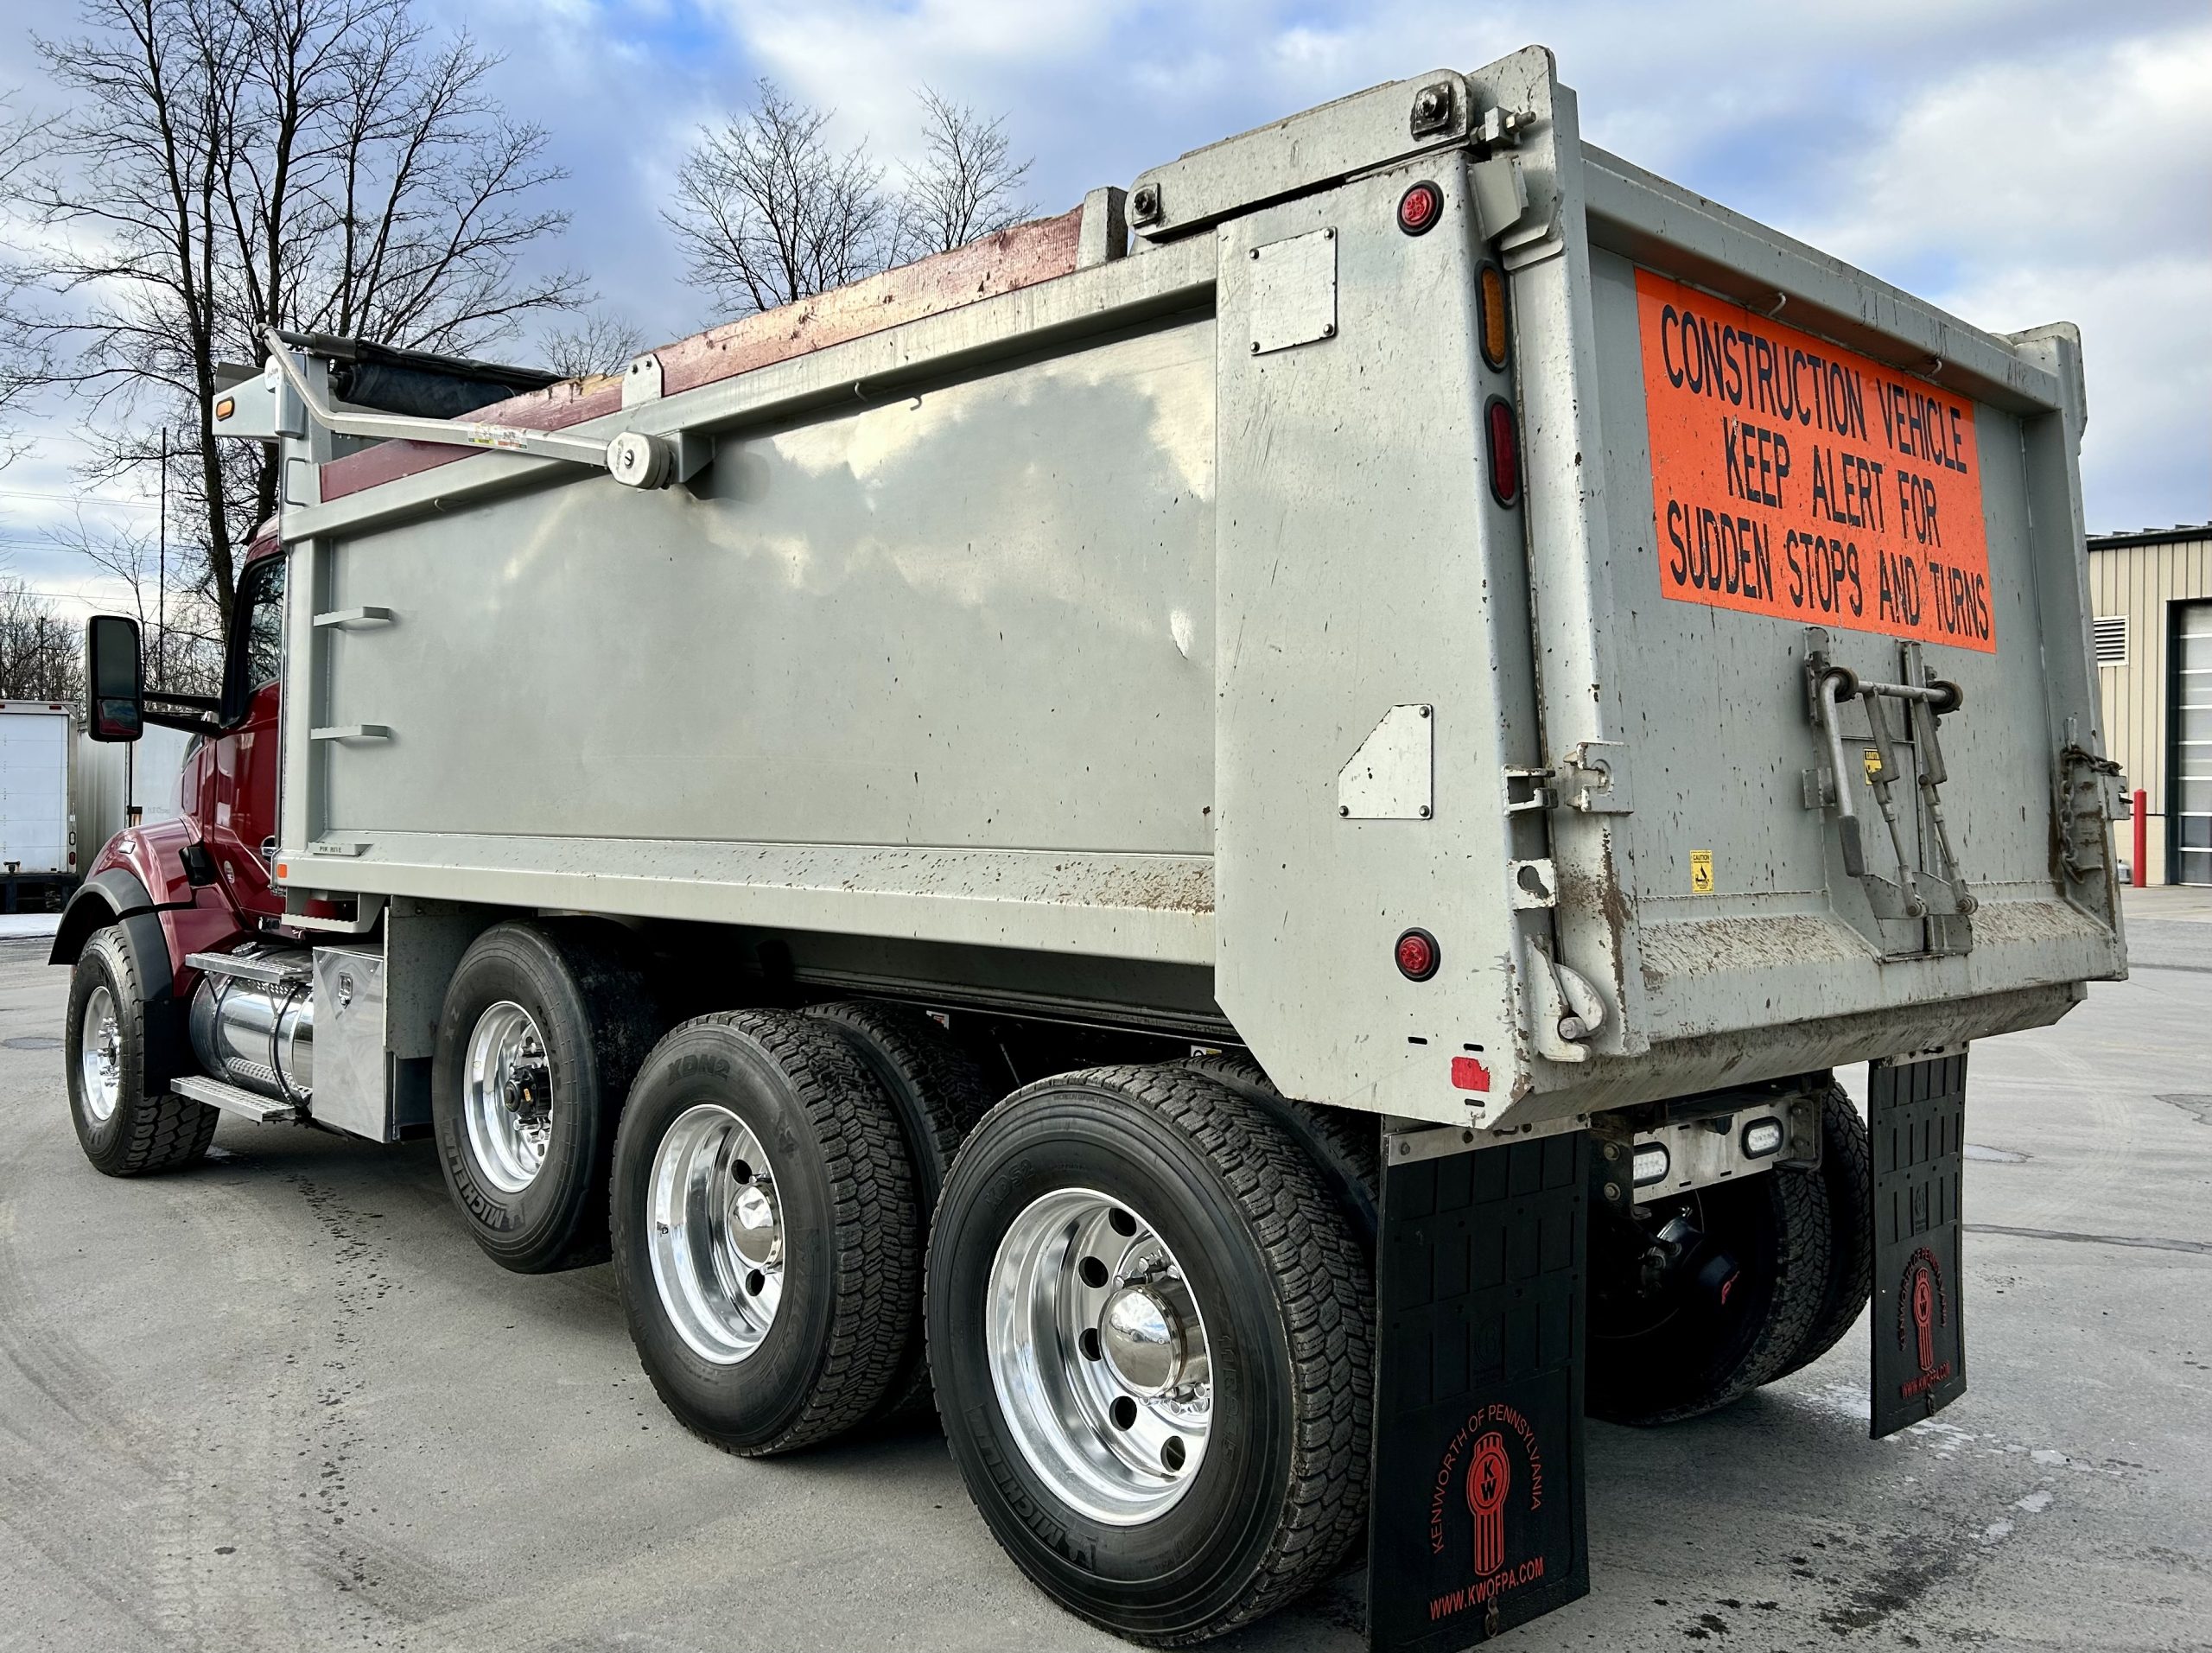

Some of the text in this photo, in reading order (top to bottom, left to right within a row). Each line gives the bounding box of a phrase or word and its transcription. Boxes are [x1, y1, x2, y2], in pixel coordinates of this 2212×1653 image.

[1662, 303, 1967, 474] CONSTRUCTION VEHICLE
[1723, 416, 1942, 548] KEEP ALERT FOR
[1667, 499, 1990, 641] SUDDEN STOPS AND TURNS
[667, 1053, 731, 1085] XDN2
[443, 1120, 505, 1230] MICHELIN
[984, 1157, 1037, 1207] XDS2
[966, 1405, 1066, 1548] MICHELIN
[1431, 1403, 1542, 1554] KENWORTH OF PENNSYLVANIA
[1480, 1480, 1497, 1503] W
[1483, 1459, 1494, 1482] K
[1429, 1556, 1545, 1621] WWW.KWOFPA.COM
